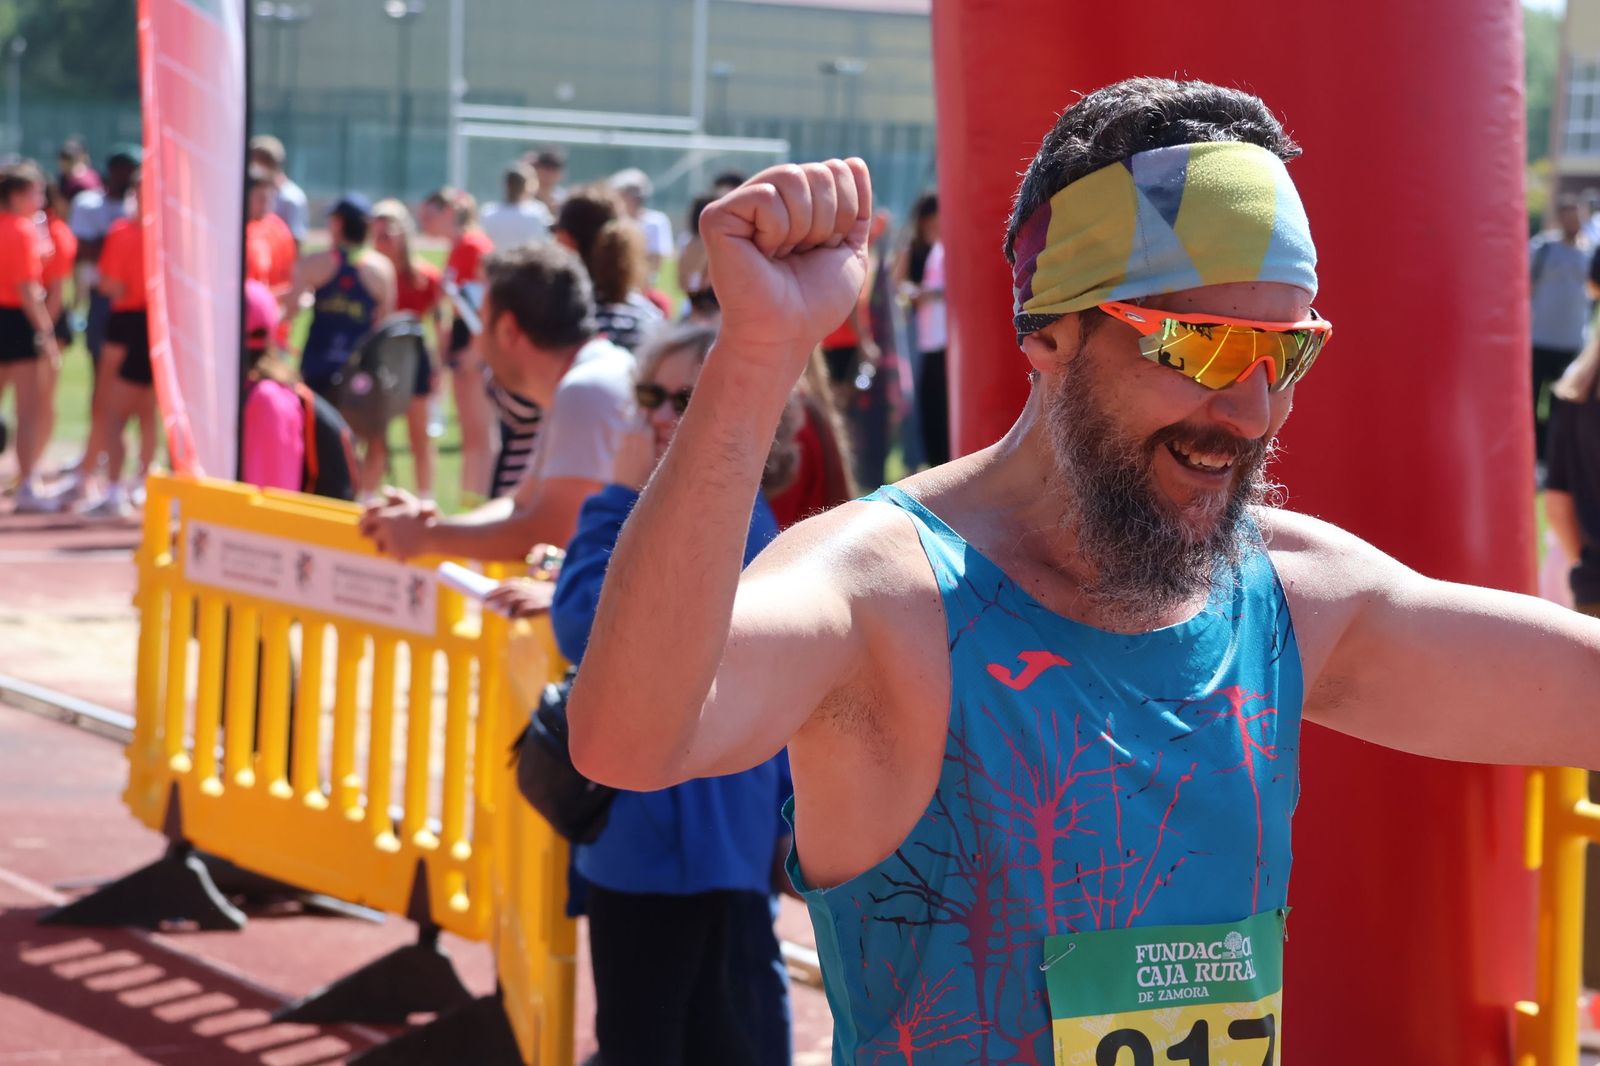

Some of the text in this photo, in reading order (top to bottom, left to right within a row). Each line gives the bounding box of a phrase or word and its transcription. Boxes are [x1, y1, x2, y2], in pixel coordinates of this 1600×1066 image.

[1136, 963, 1188, 987] CAJA
[1138, 986, 1210, 1003] DE ZAMORA
